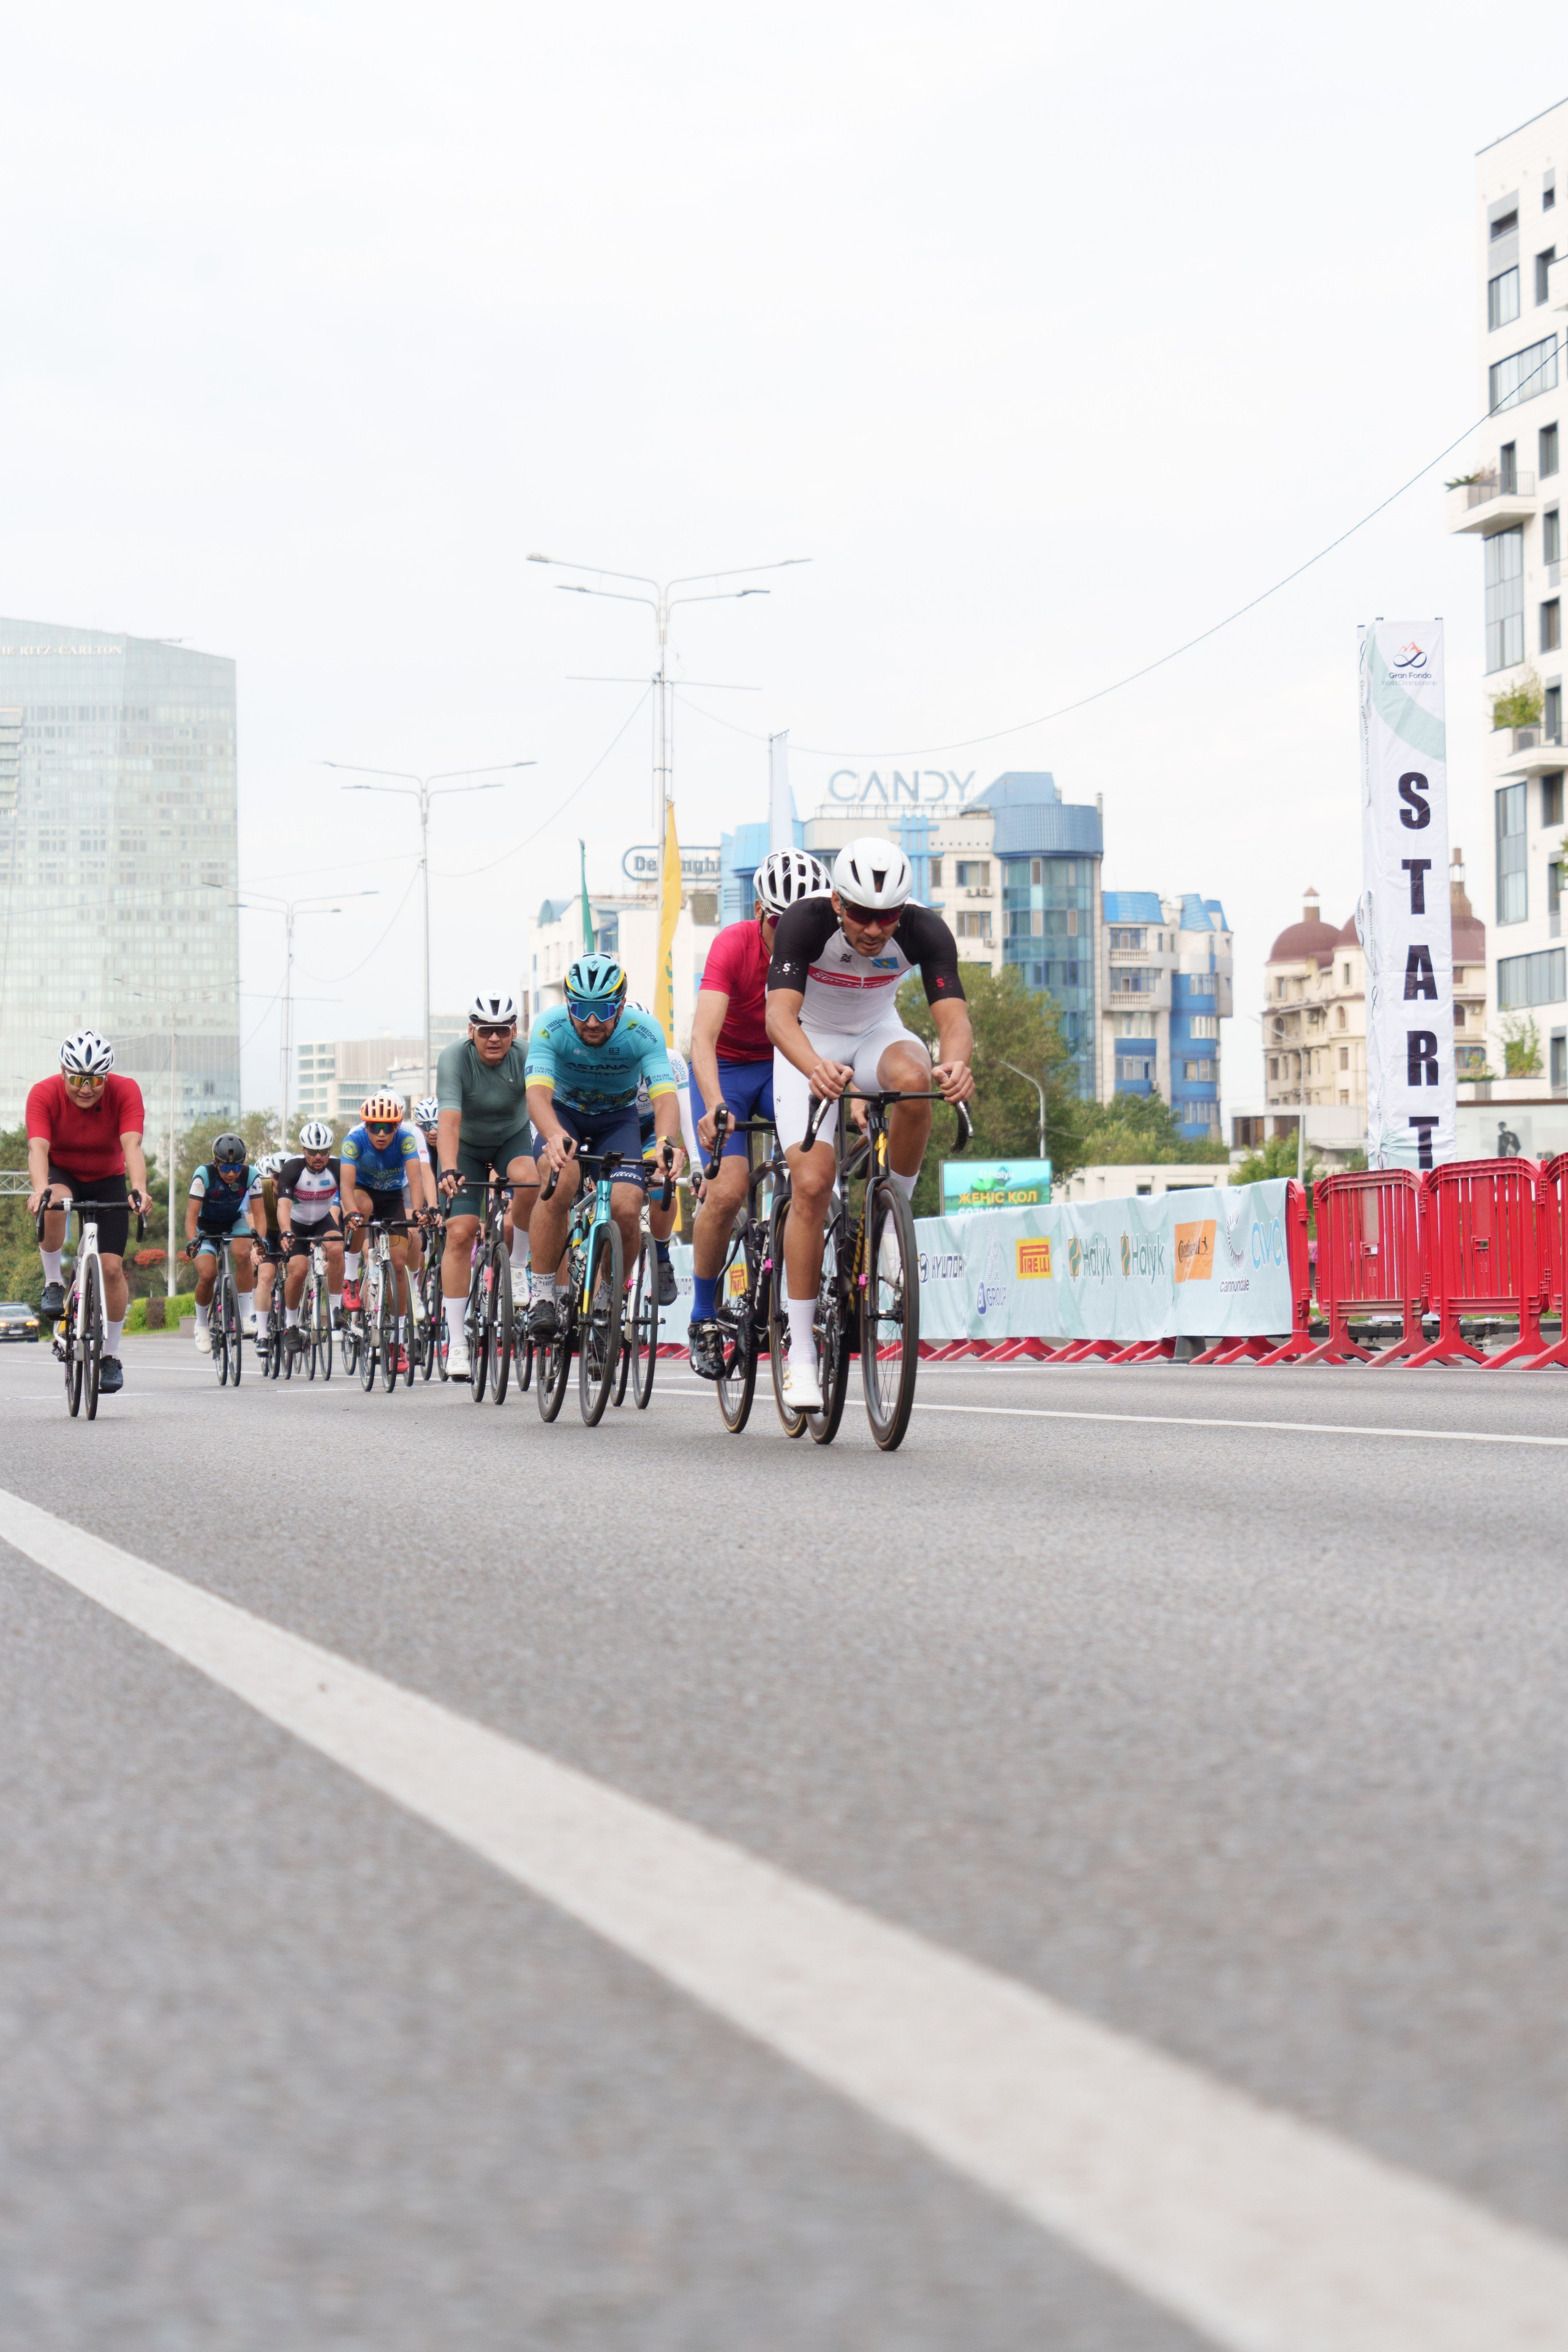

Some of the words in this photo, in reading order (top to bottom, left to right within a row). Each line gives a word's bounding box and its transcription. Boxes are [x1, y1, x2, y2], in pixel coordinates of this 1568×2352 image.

[828, 769, 976, 802] CANDY
[638, 1025, 658, 1043] FREEDOM
[671, 1060, 687, 1080] alatau
[1008, 1191, 1038, 1204] ҚОЛ
[1019, 1245, 1050, 1274] PIRELLI
[1080, 1236, 1112, 1286] Halyk
[1131, 1234, 1165, 1285] Halyk
[1219, 1276, 1250, 1293] cannondale
[986, 1287, 1006, 1308] GROUP
